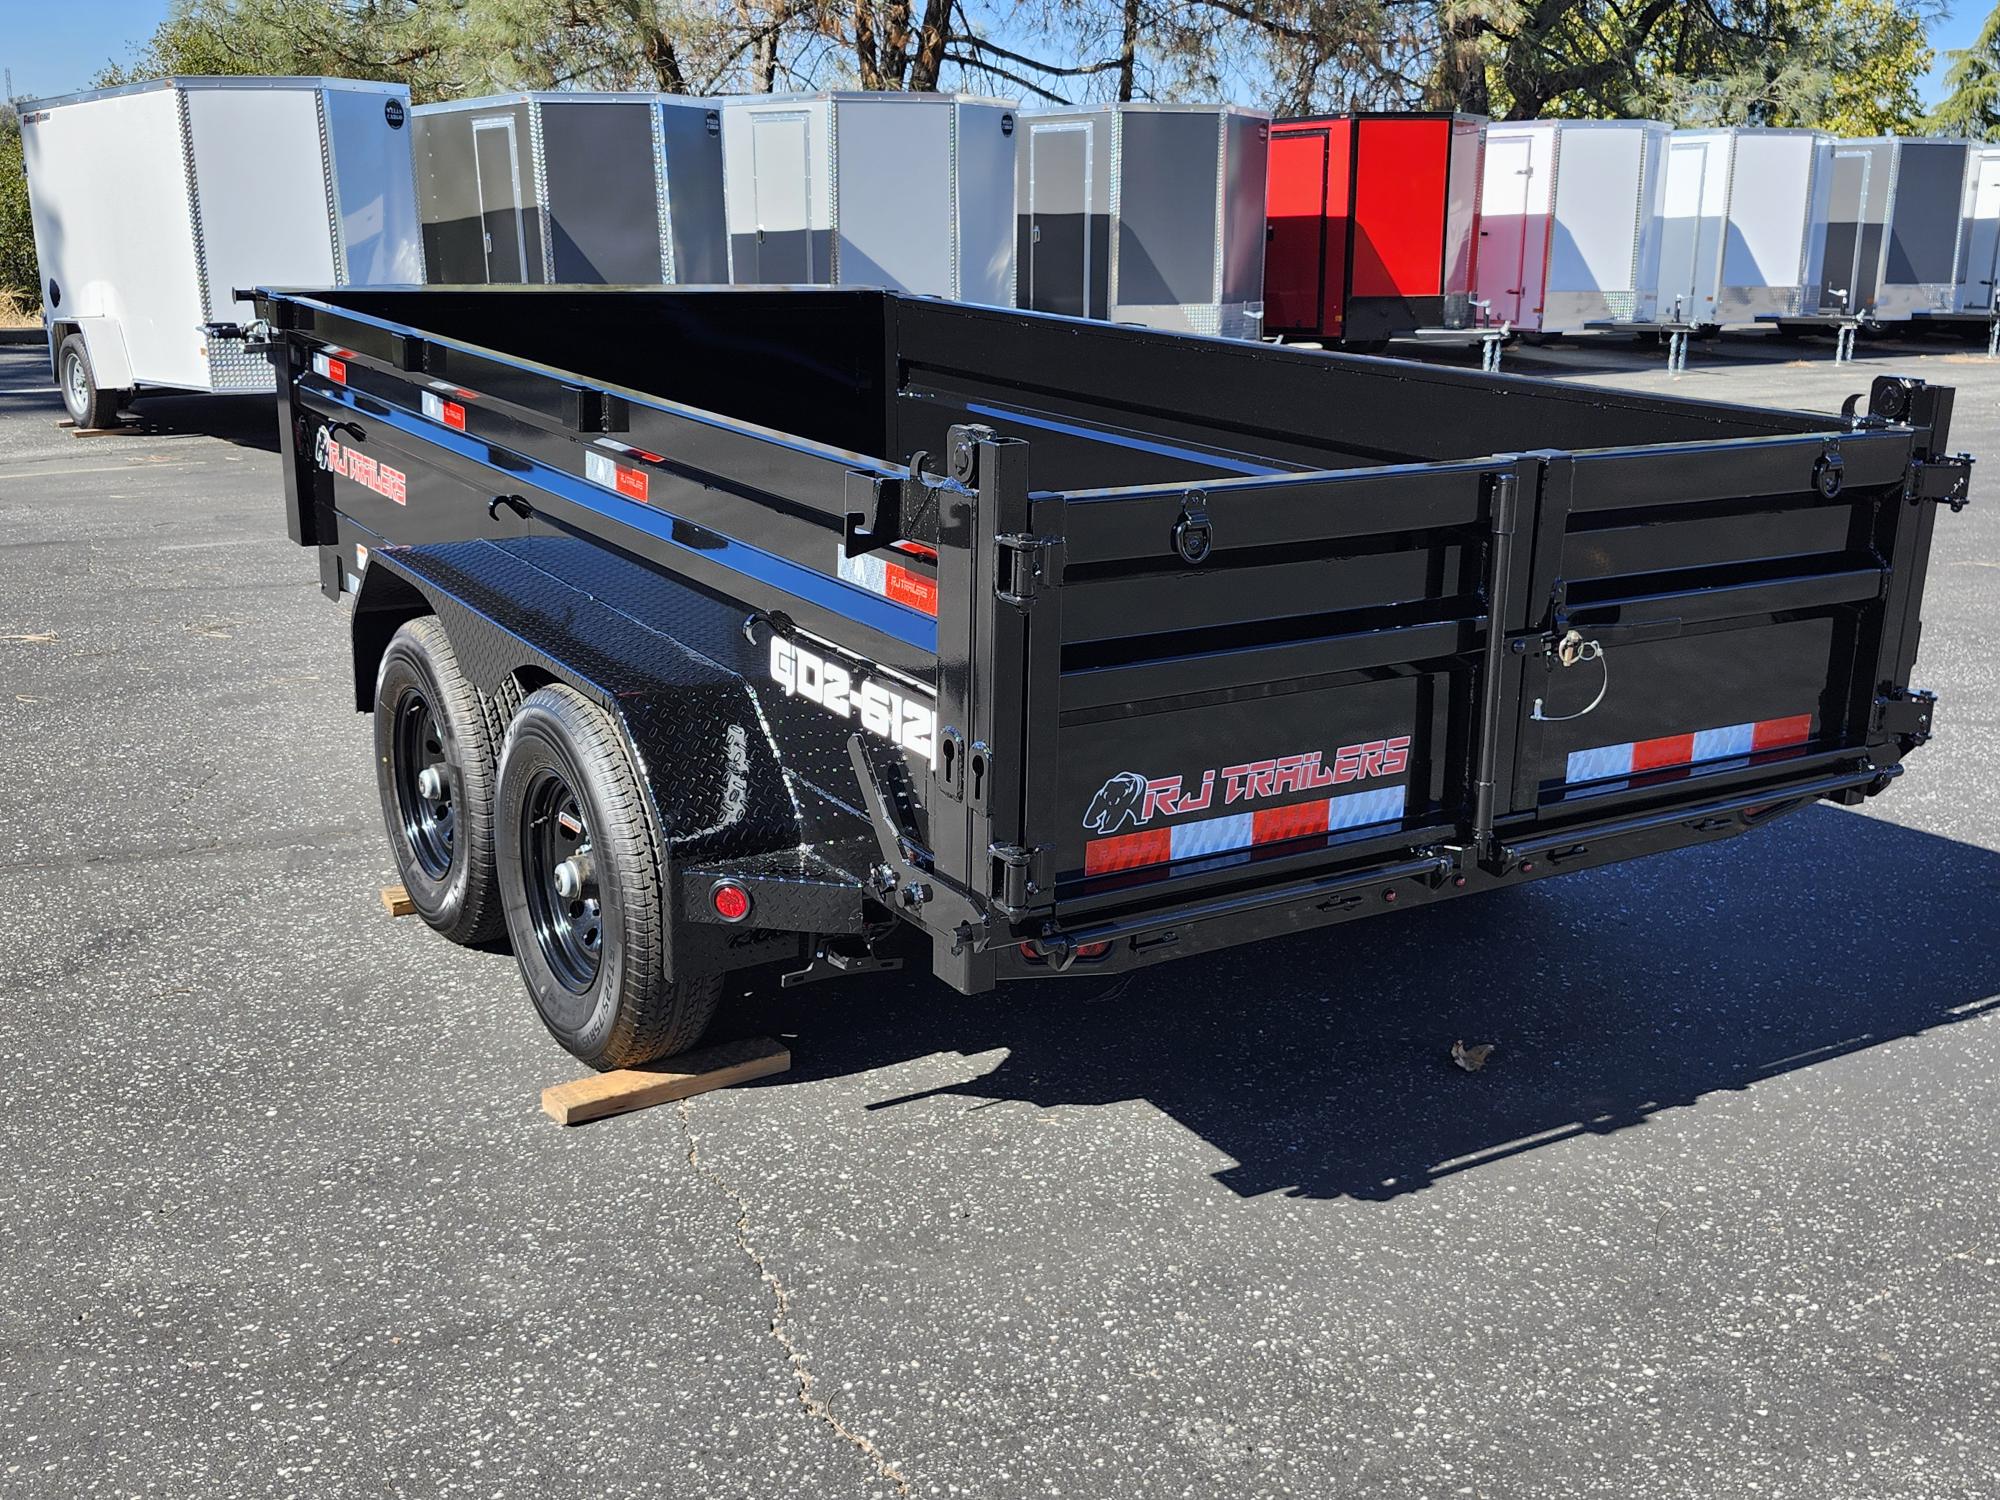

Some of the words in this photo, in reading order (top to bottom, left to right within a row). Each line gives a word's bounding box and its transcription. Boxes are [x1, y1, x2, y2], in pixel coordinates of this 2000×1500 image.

[328, 439, 348, 476] RJ
[347, 447, 406, 506] TRAILERS
[770, 635, 937, 771] GD2-612
[1142, 769, 1216, 819] RJ
[1221, 735, 1411, 804] TRAILERS
